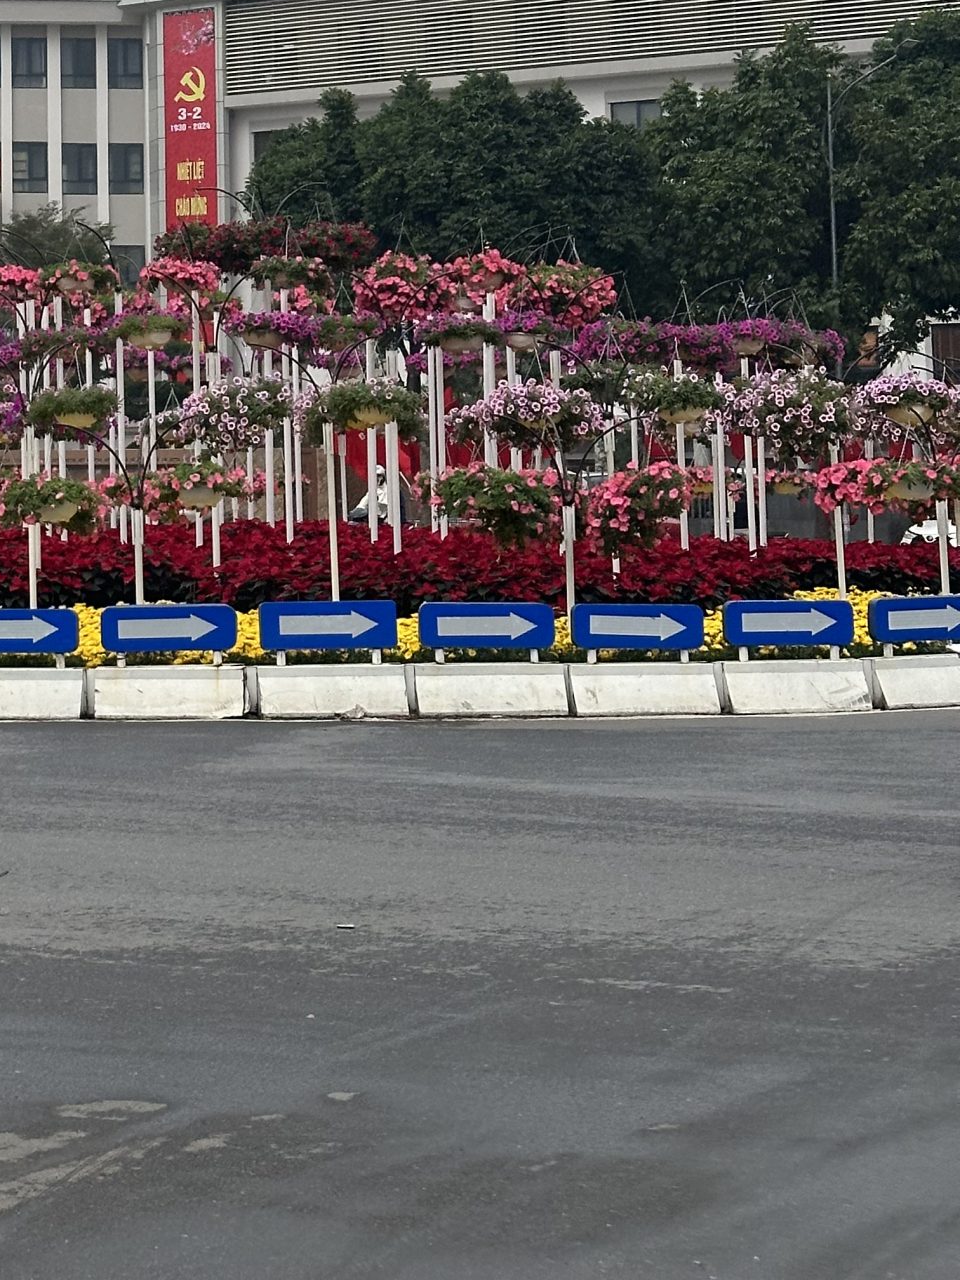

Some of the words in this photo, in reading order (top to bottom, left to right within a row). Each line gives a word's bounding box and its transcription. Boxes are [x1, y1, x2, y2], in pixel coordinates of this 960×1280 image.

[177, 106, 202, 120] 3-2
[170, 123, 187, 133] 1930
[192, 121, 211, 131] 2024
